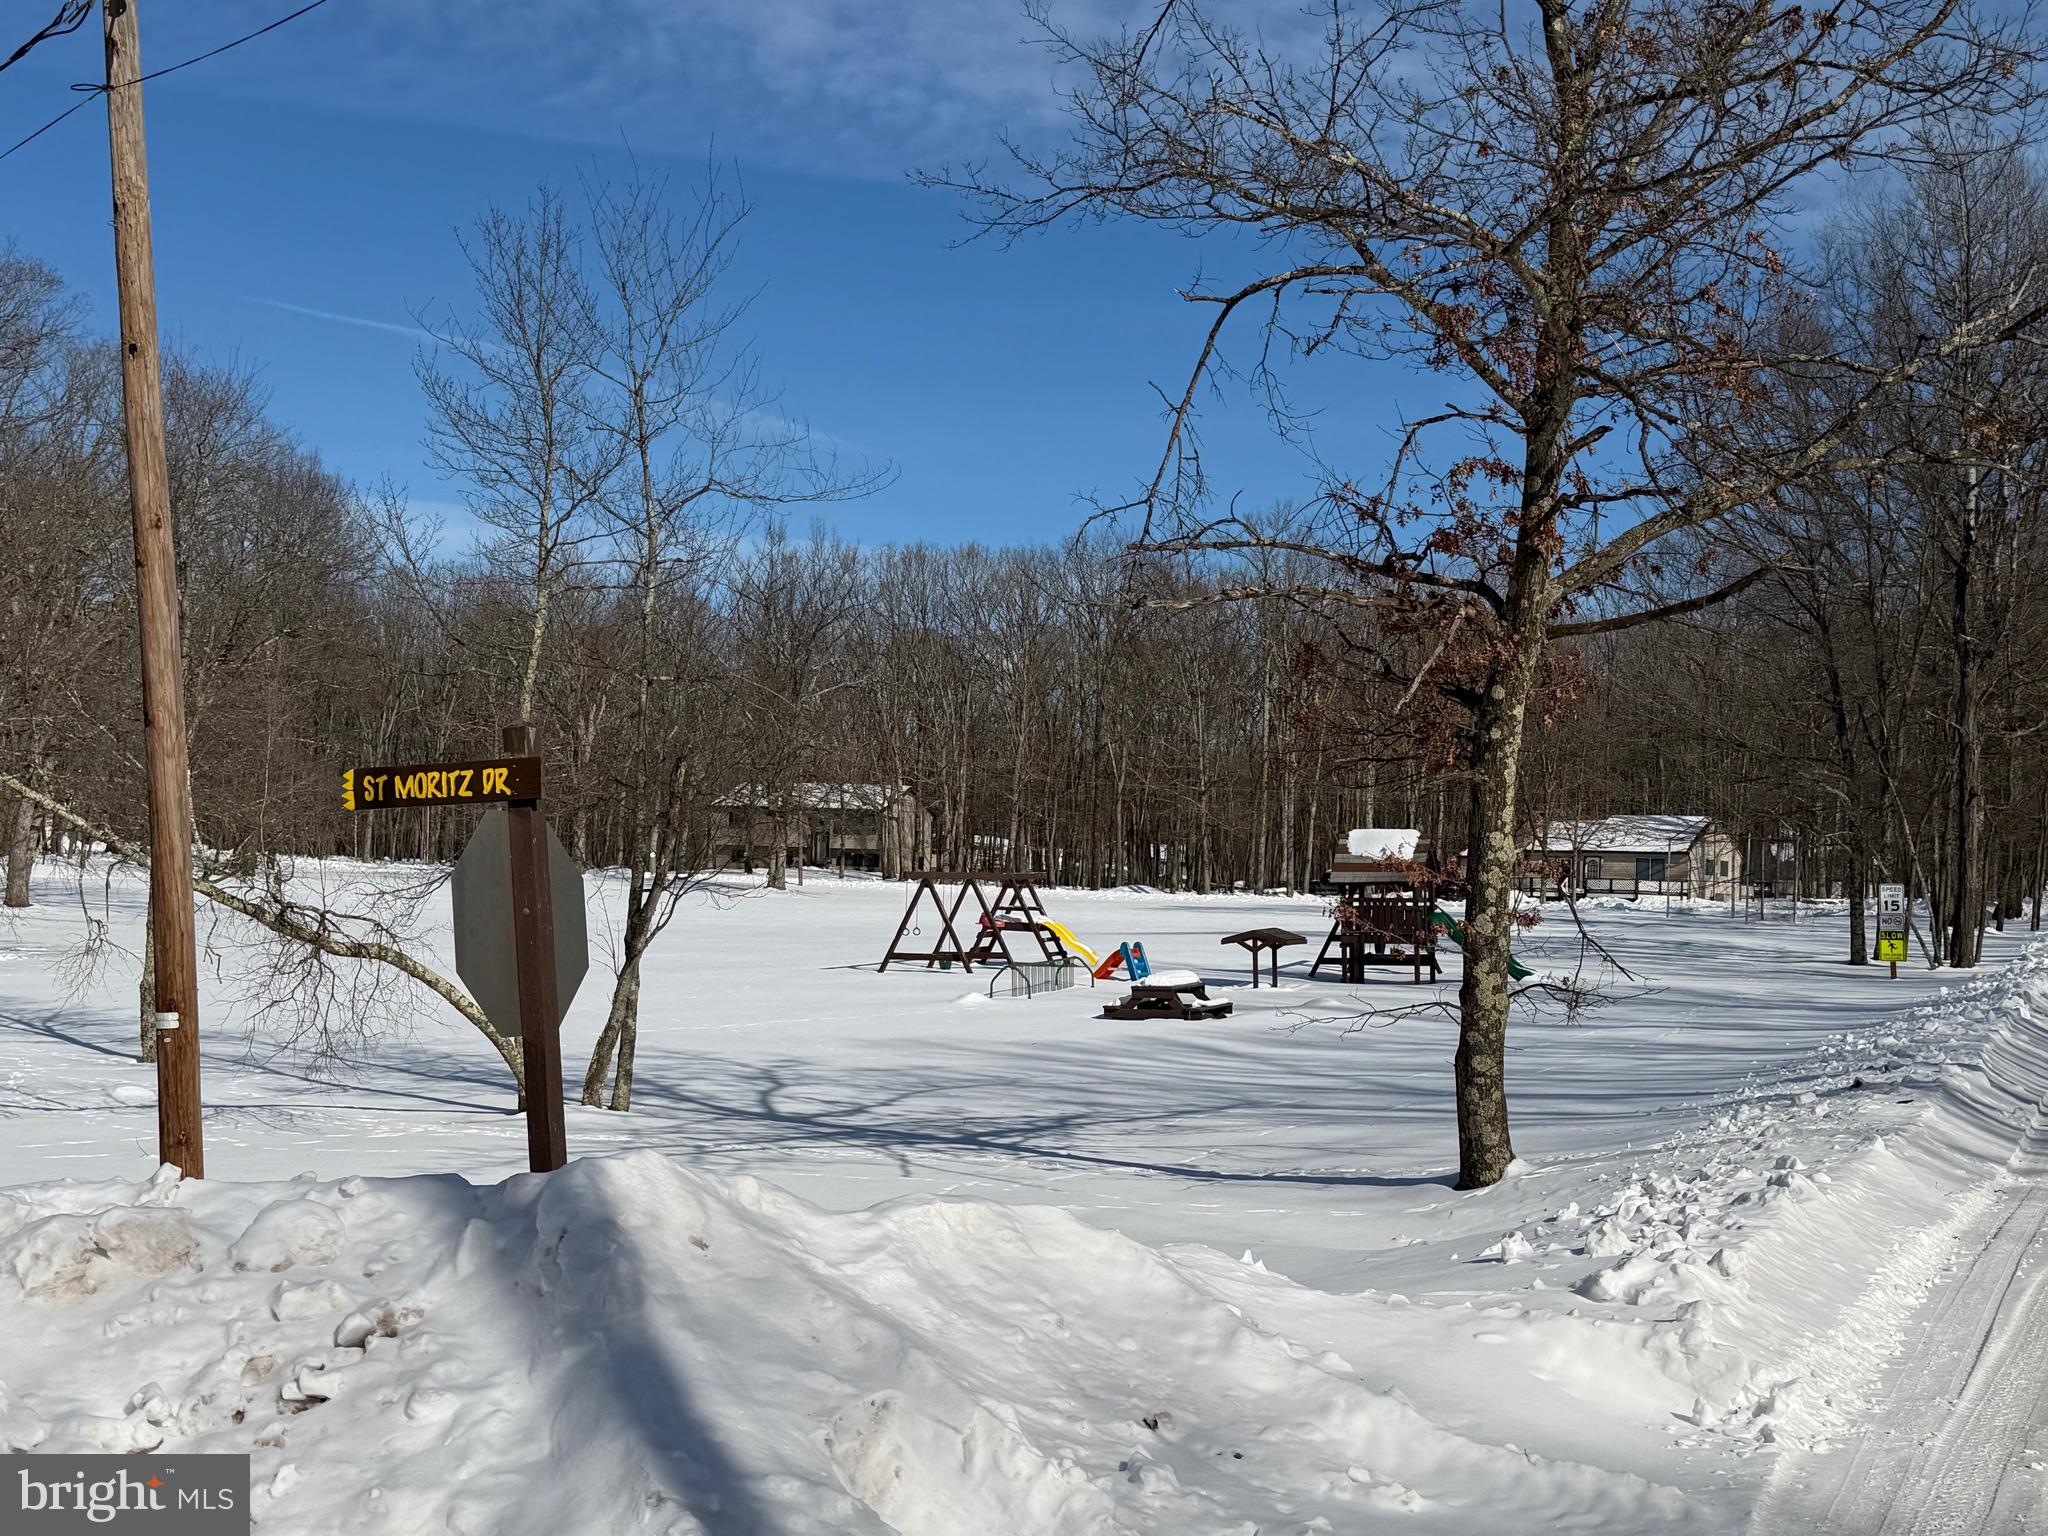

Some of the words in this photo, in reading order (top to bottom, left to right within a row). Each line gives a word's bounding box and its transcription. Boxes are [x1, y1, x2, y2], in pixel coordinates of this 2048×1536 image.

[363, 775, 388, 801] ST
[394, 769, 474, 799] MORITZ
[482, 767, 512, 796] DR
[1883, 900, 1900, 912] 15
[1881, 917, 1893, 925] NO
